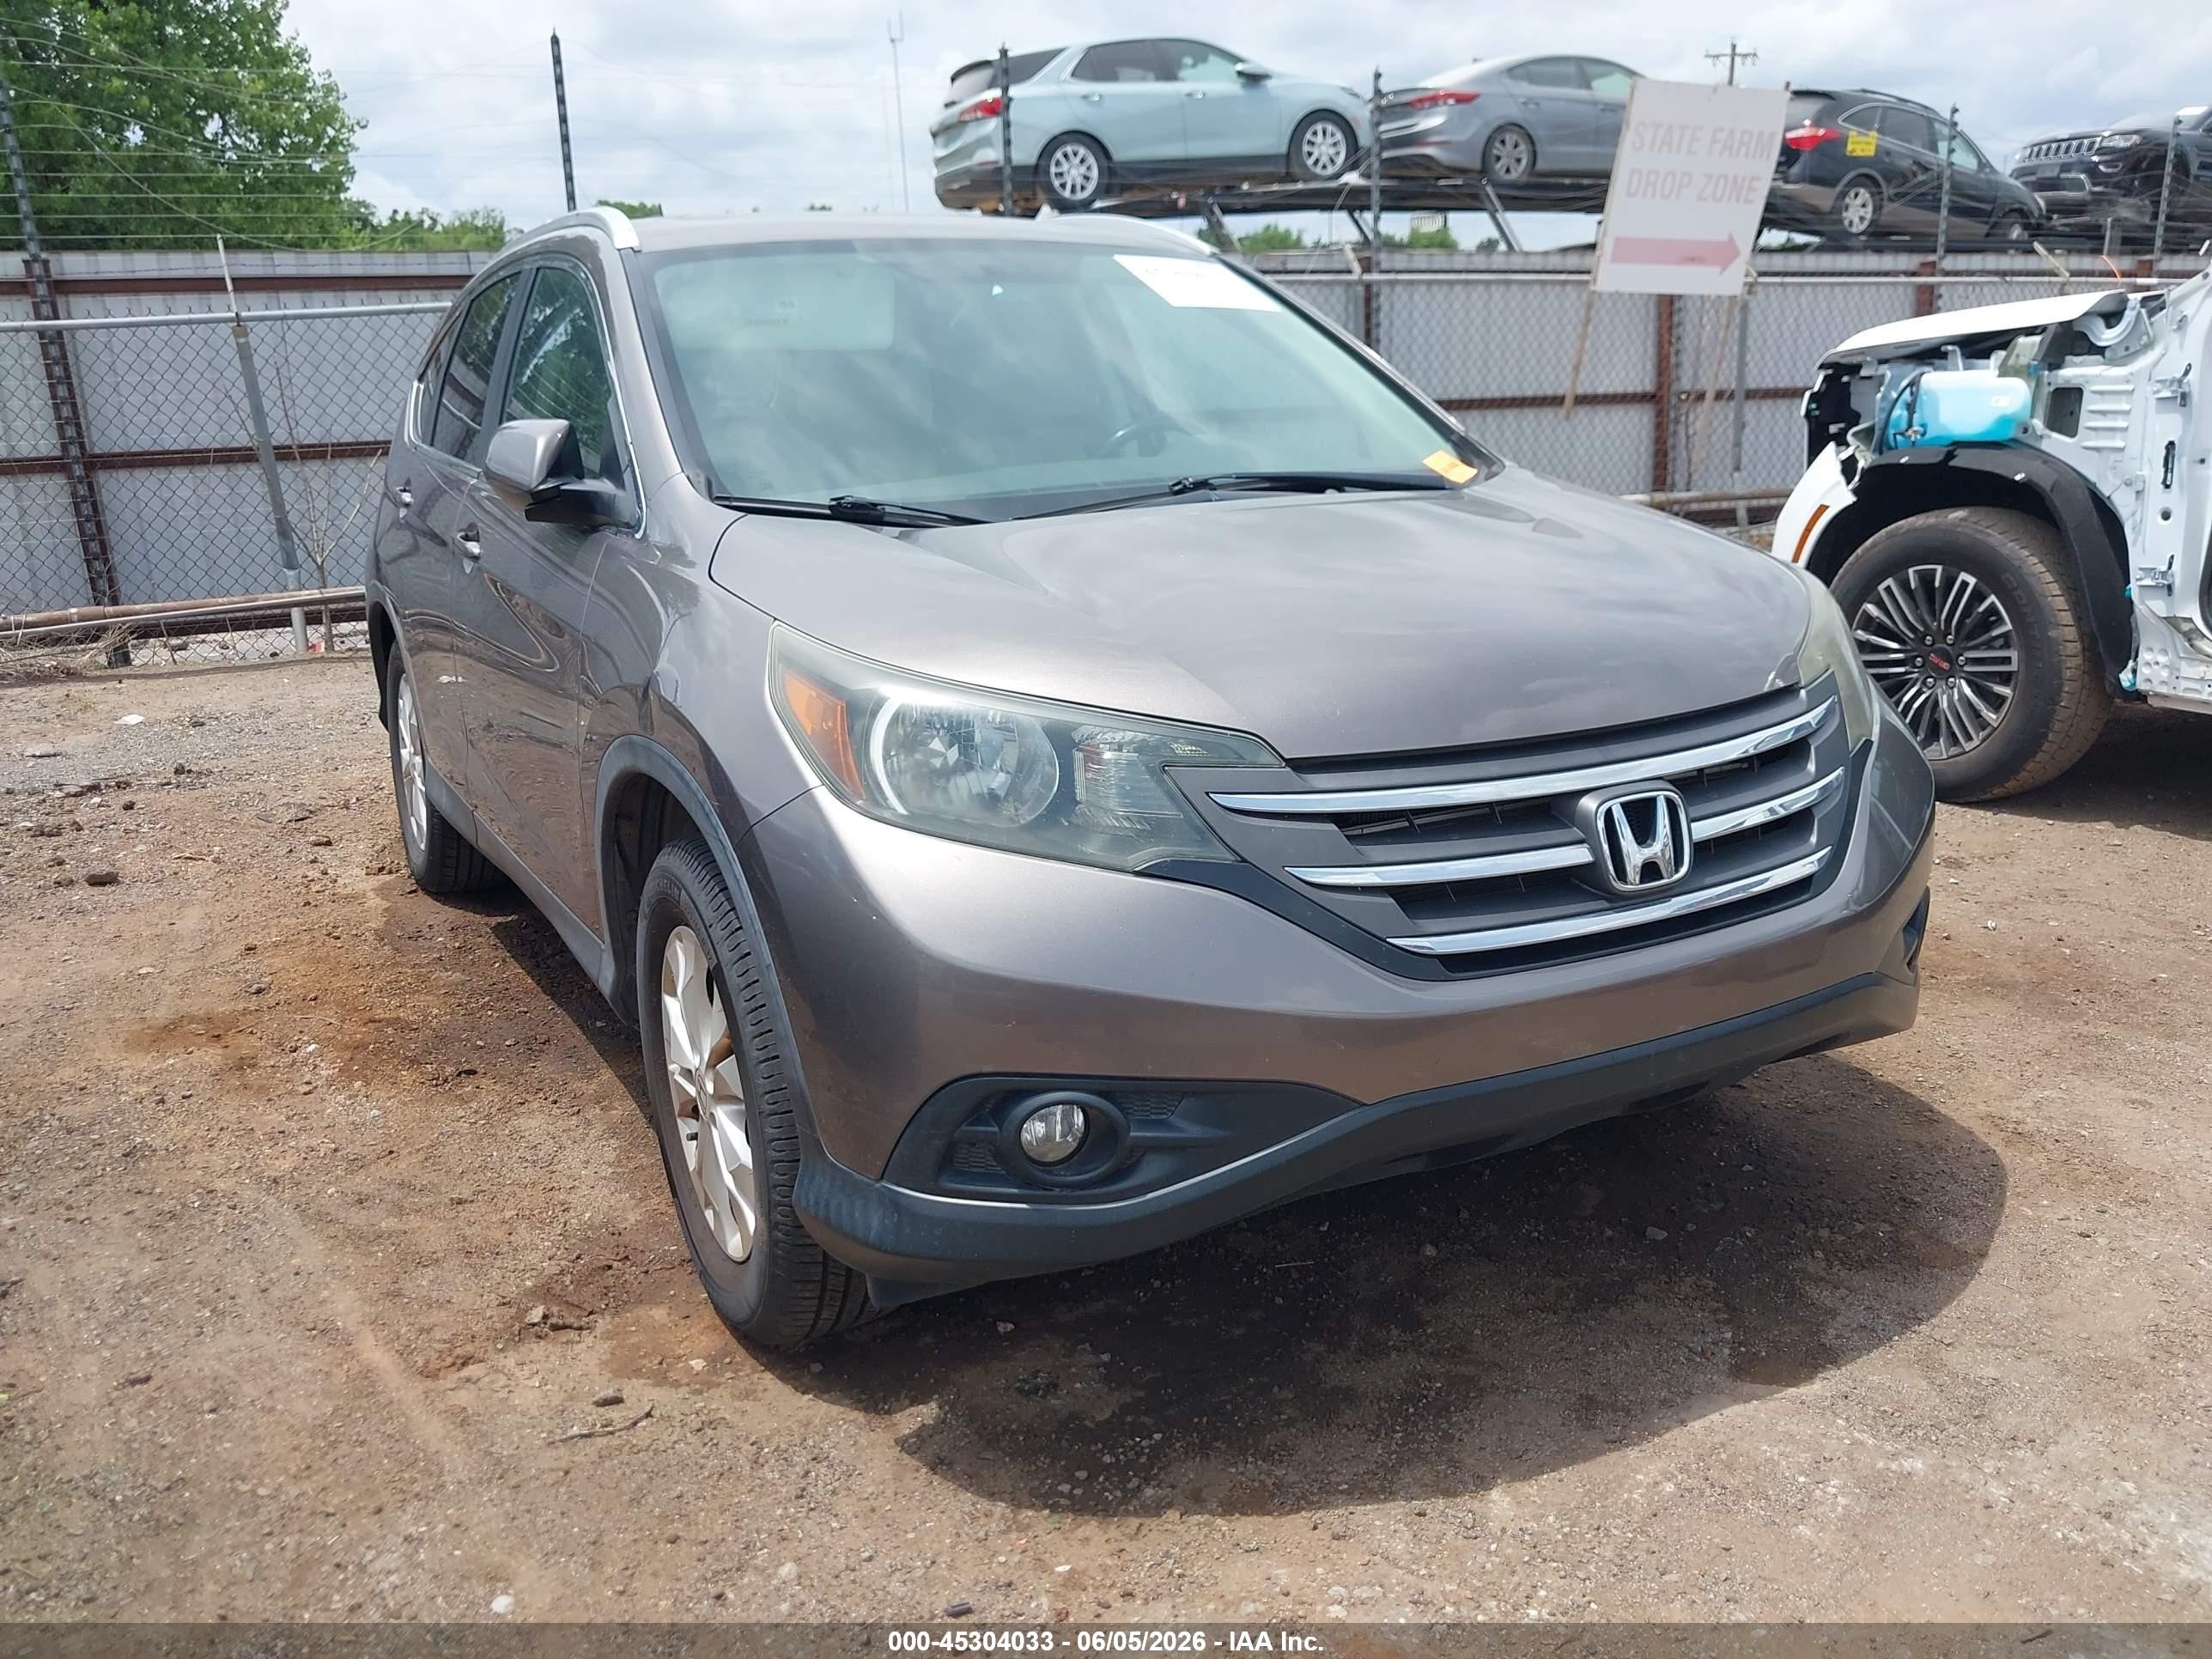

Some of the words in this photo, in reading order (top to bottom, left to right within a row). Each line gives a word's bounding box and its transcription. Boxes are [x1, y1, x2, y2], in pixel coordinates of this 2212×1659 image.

[1632, 120, 1705, 156] STATE
[1706, 126, 1778, 161] FARM
[1625, 167, 1693, 200] DROP
[1697, 173, 1762, 205] ZONE
